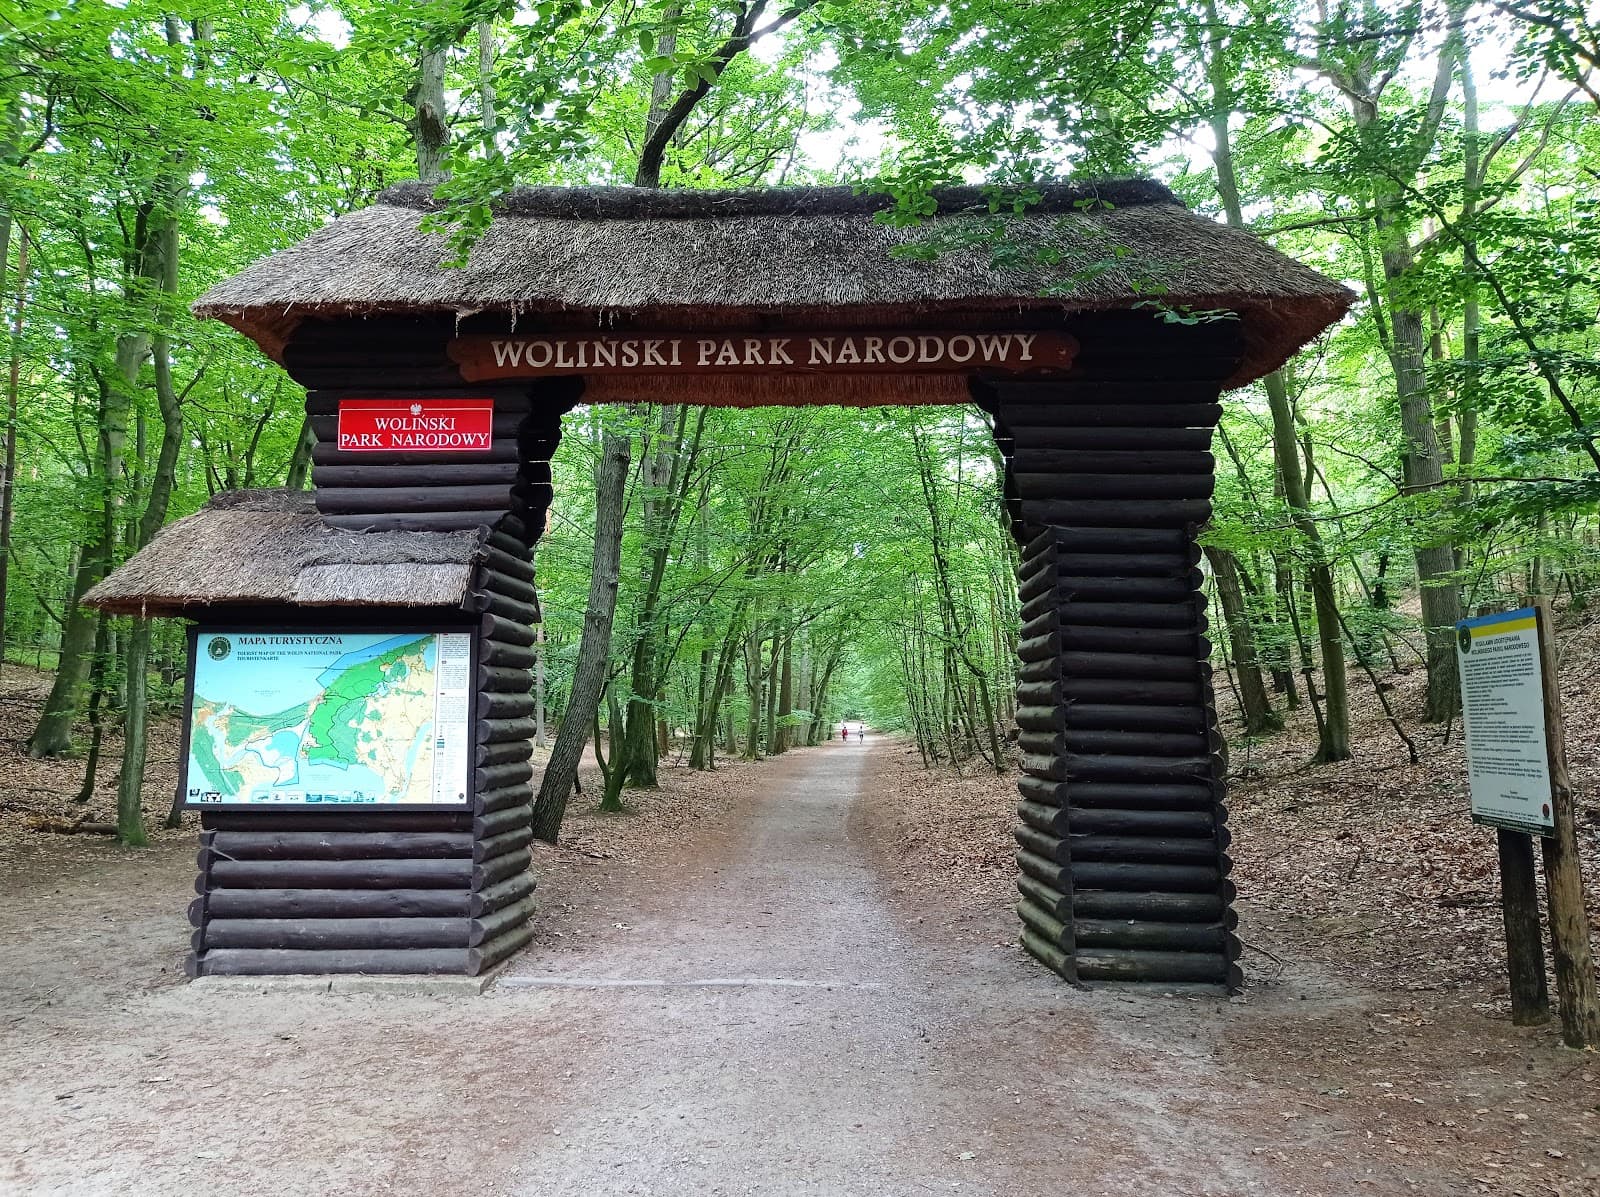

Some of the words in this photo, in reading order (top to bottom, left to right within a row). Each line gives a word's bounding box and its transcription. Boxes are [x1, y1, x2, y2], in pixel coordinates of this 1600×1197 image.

[491, 336, 682, 368] WOLIŃSKI
[697, 338, 794, 366] PARK
[808, 334, 1037, 365] NARODOWY
[374, 415, 456, 431] WOLIŃSKI
[341, 433, 383, 447] PARK
[391, 432, 489, 447] NARODOWY
[239, 636, 267, 645] MAPA
[269, 636, 343, 645] TURYSTYCZNA
